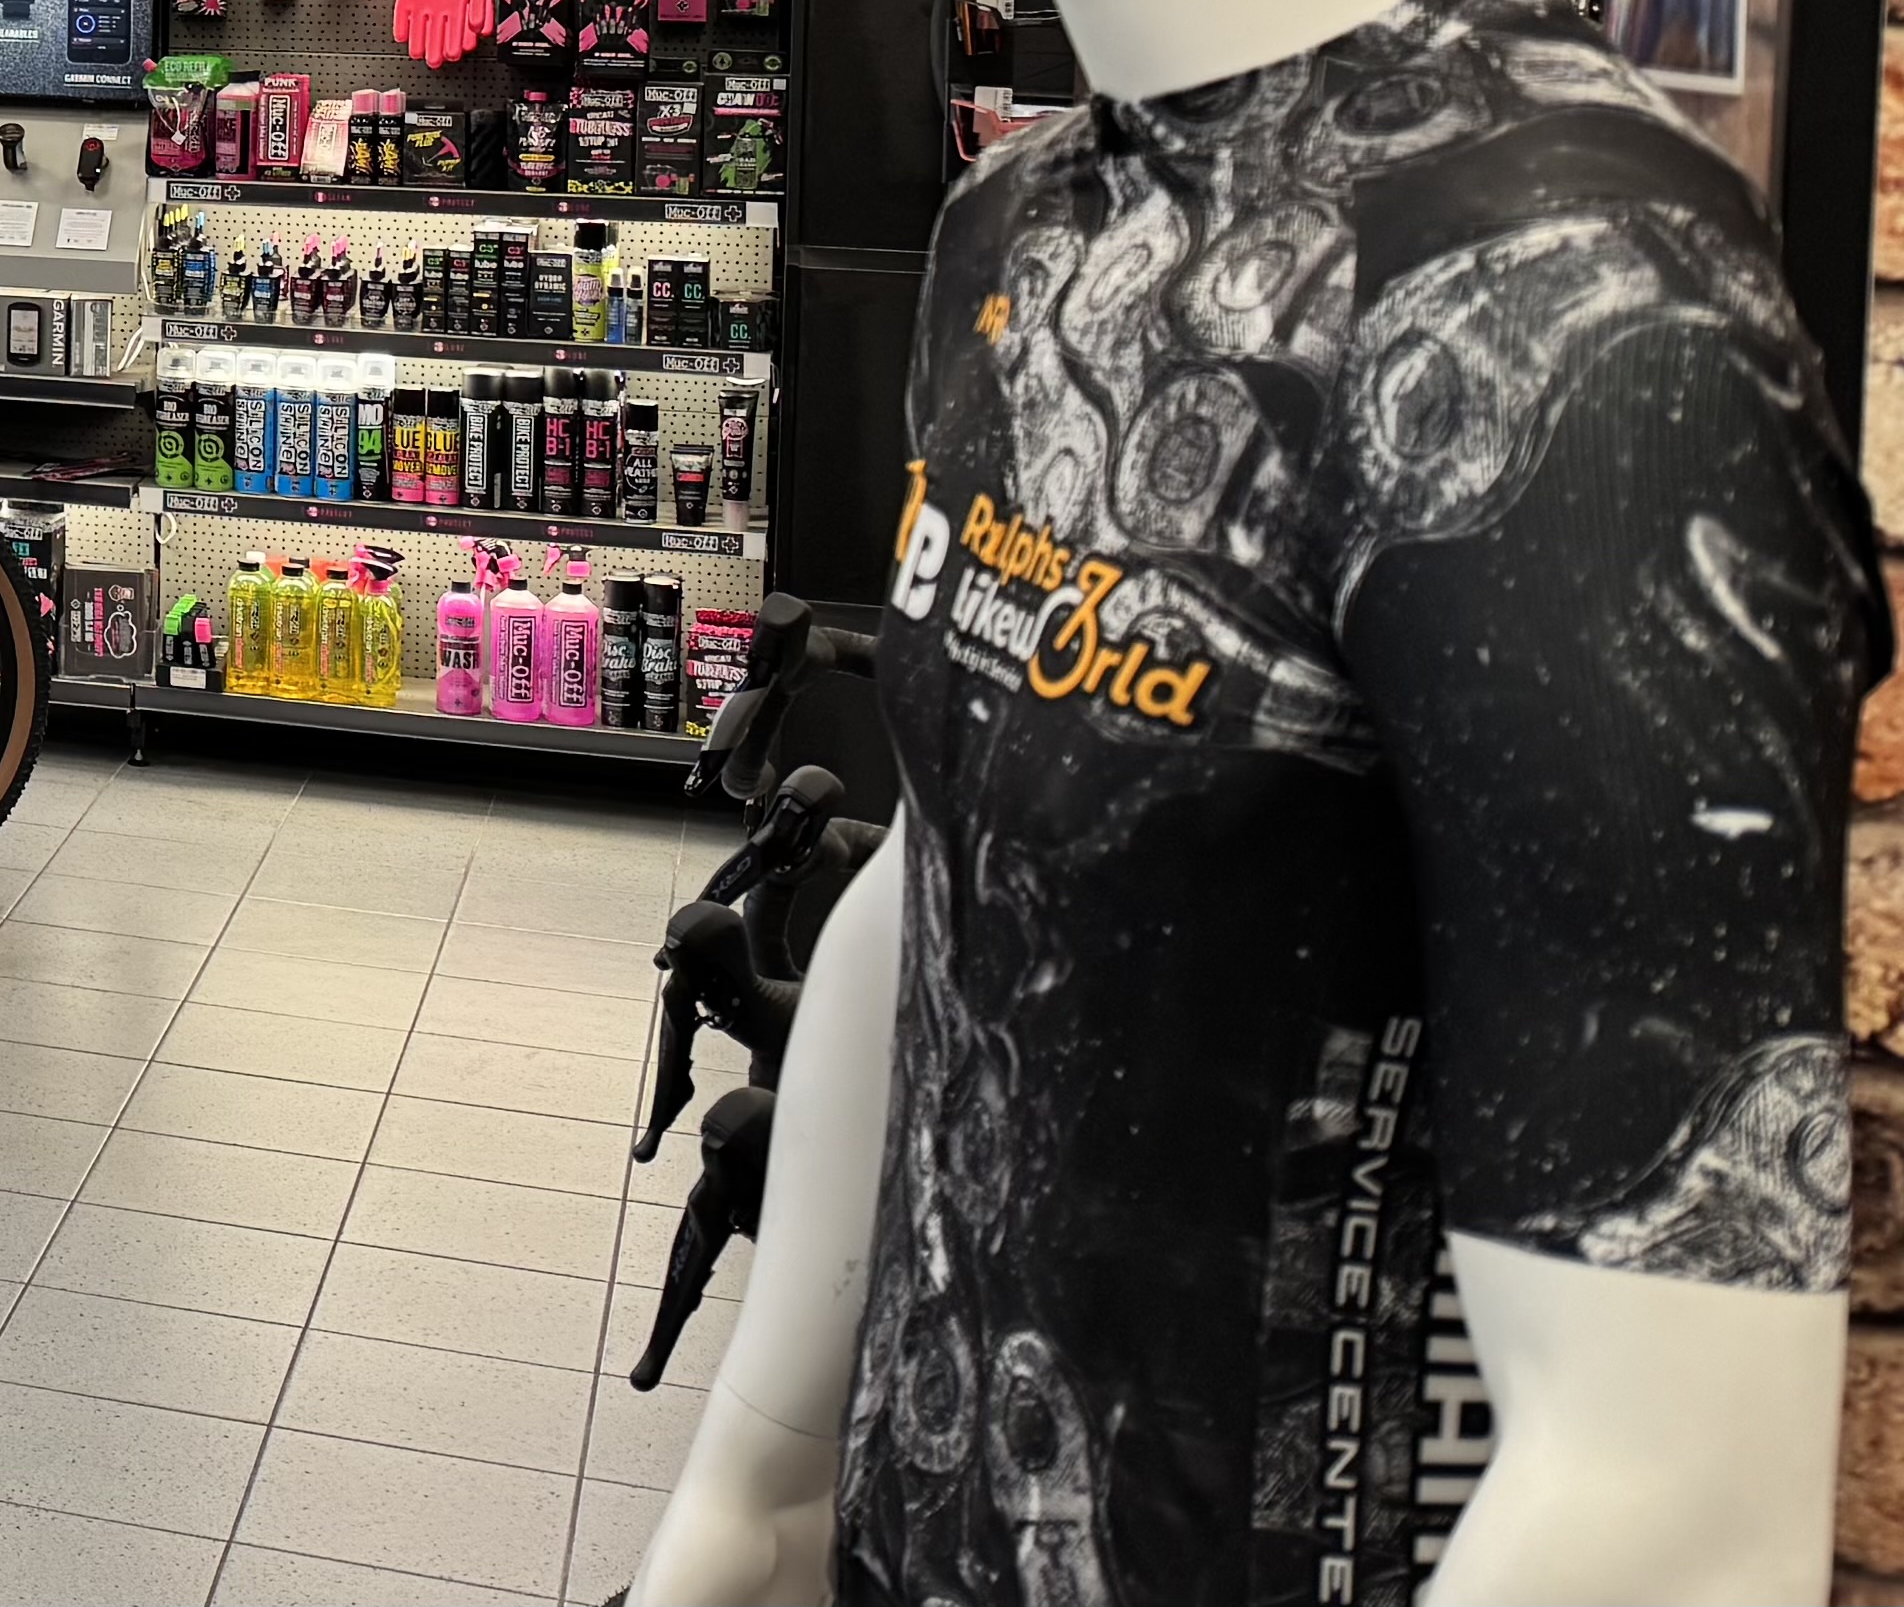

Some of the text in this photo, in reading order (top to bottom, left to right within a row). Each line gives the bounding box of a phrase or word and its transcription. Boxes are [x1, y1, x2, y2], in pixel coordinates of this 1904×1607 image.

[165, 61, 185, 74] ECO
[97, 74, 132, 86] CONNECT
[264, 77, 297, 88] PUNK
[269, 95, 289, 161] Muc-Off
[170, 184, 221, 199] Muc-Off
[666, 204, 720, 220] Muc-Off
[652, 281, 675, 298] CC.
[683, 282, 706, 299] CC.
[50, 297, 65, 368] GARMIN
[166, 322, 218, 339] Muc-Off
[730, 323, 752, 340] CC.
[663, 354, 719, 373] Muc-Off
[248, 399, 265, 471] SILICON
[546, 417, 571, 438] HC
[586, 420, 611, 440] HC
[295, 402, 312, 475] SILICON
[333, 405, 350, 477] SILICON
[358, 433, 383, 454] 94
[392, 430, 422, 448] LUE
[546, 438, 571, 456] B-1
[470, 413, 485, 490] BIKE PROTECT
[514, 416, 532, 492] BIKE PROTECT
[585, 439, 611, 459] B-1
[167, 493, 218, 511] Muc-Off
[662, 533, 719, 551] Muc-Off
[440, 649, 480, 669] WASH
[510, 619, 533, 702] Muc-Off
[642, 644, 672, 661] Disc
[563, 622, 586, 707] Muc-Off
[1318, 1017, 1421, 1607] SERVICE CENTE
